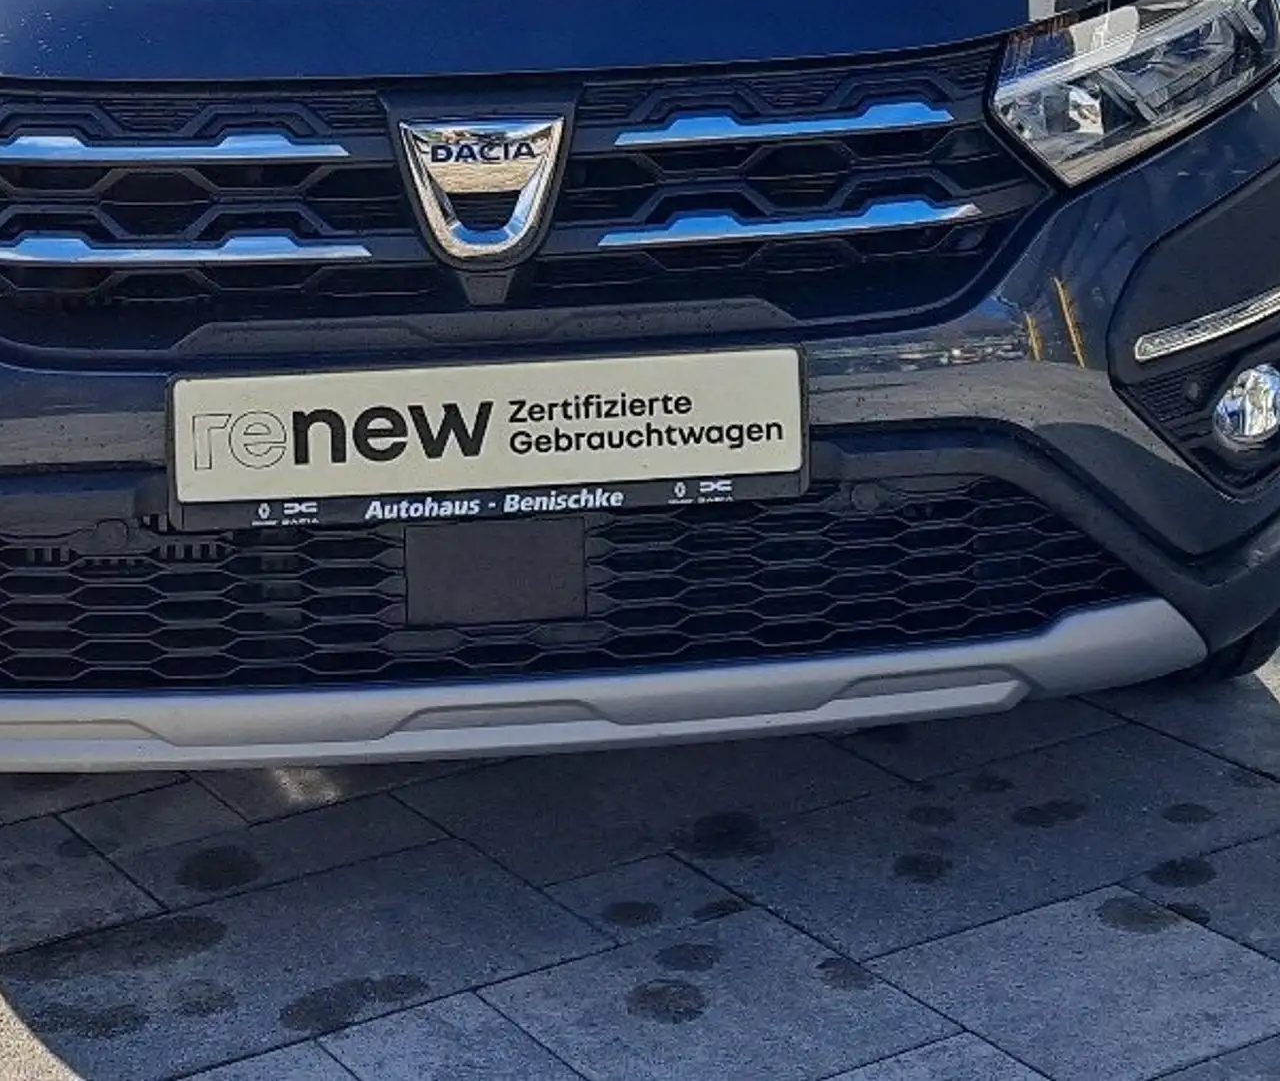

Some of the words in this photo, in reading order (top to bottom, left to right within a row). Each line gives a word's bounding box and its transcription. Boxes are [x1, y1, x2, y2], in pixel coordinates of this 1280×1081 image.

[431, 142, 536, 164] DACIA
[508, 392, 692, 423] Zertifizierte
[192, 401, 494, 470] renew
[509, 421, 783, 455] Gebrauchtwagen
[365, 497, 480, 519] Autohaus
[503, 488, 624, 513] Benischke
